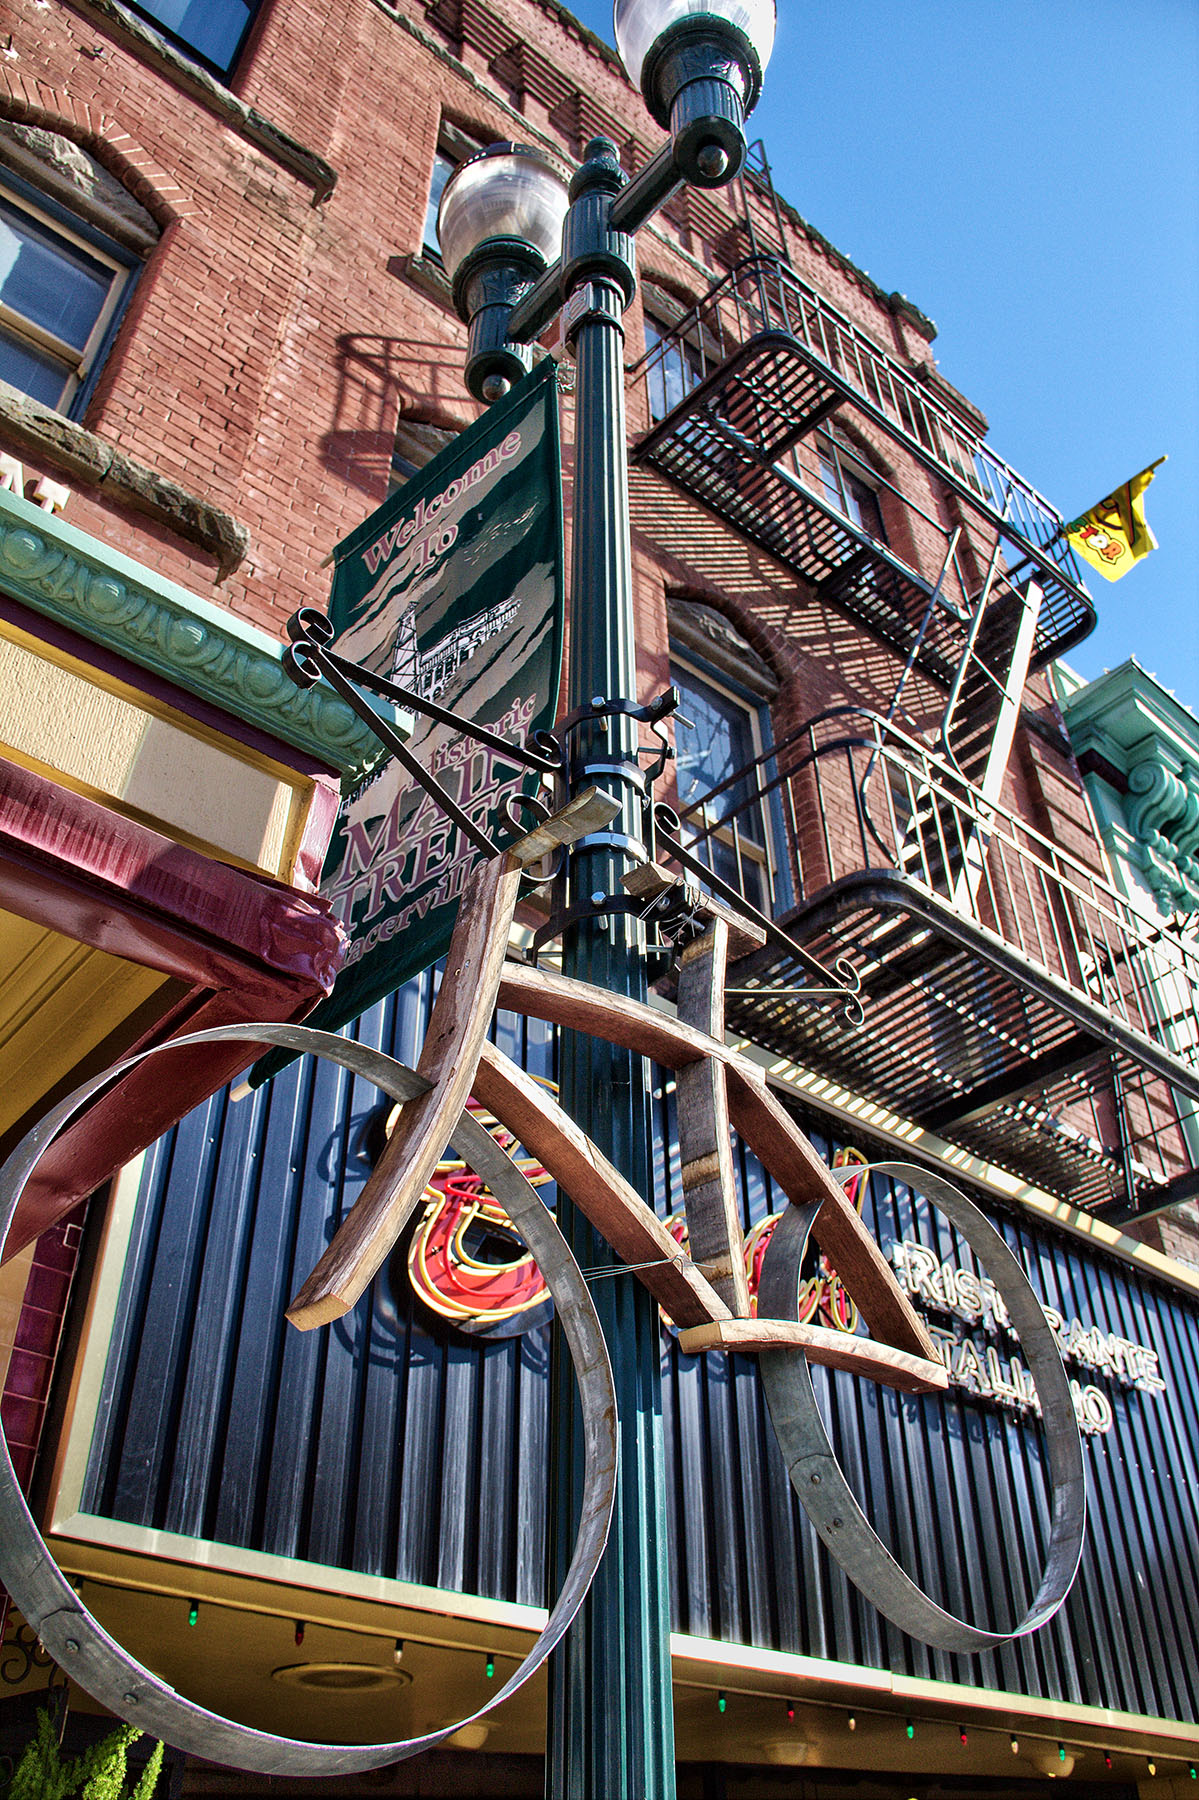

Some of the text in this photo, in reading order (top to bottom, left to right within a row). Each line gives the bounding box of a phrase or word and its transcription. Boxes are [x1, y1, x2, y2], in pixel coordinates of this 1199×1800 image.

[361, 430, 522, 575] Welcome
[410, 523, 459, 575] To
[319, 764, 537, 932] TREET
[333, 719, 531, 890] MAIN
[898, 1239, 1167, 1392] RISTRANTE
[918, 1320, 1113, 1434] TALIO
